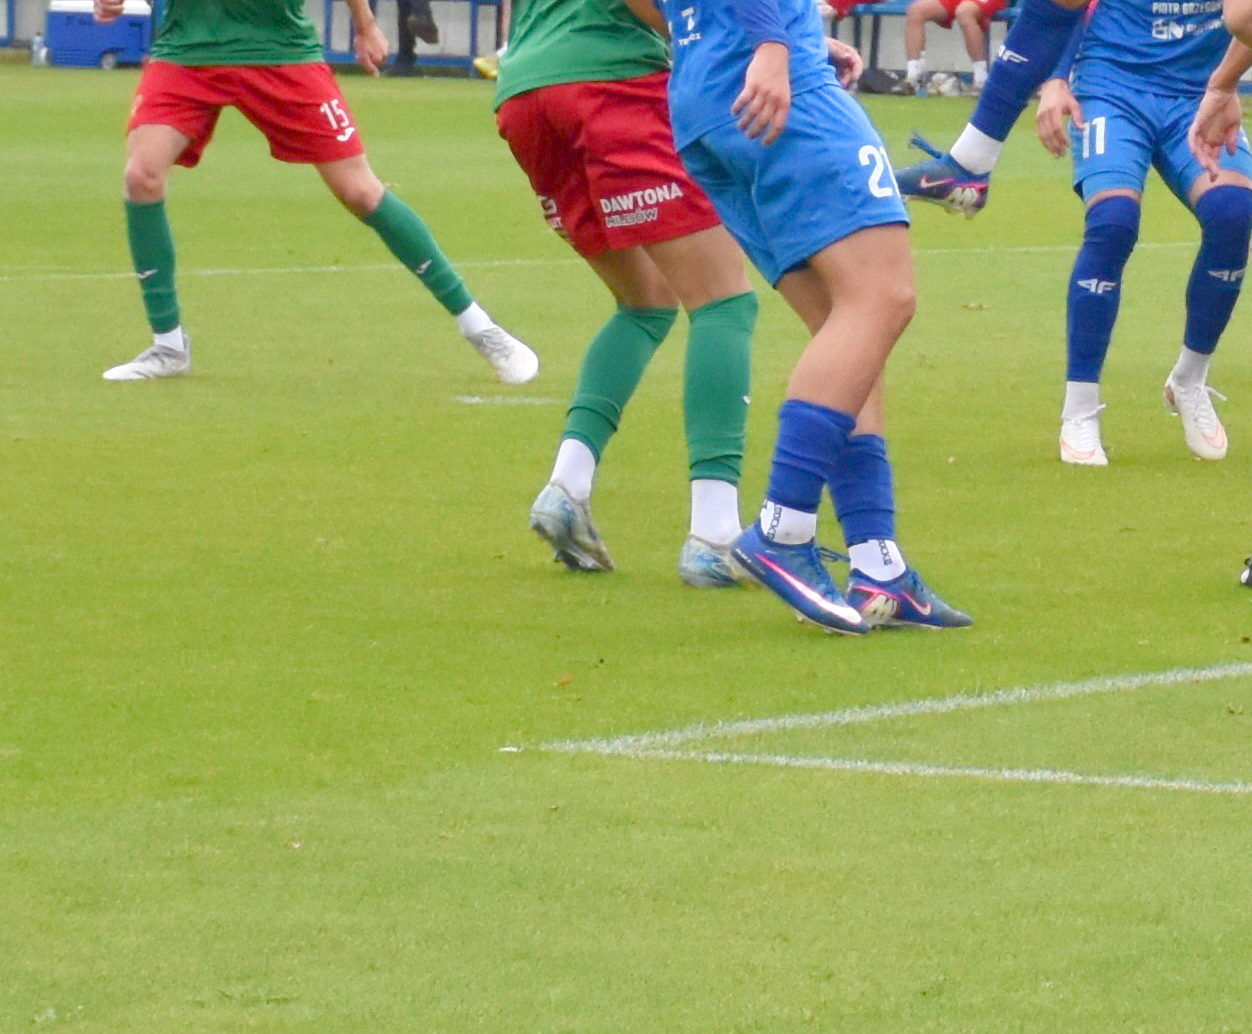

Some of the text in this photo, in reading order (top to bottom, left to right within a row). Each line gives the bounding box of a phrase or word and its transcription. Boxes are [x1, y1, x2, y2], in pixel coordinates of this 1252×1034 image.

[320, 98, 350, 130] 15
[1081, 117, 1106, 159] 11
[600, 182, 684, 214] DAWTONA
